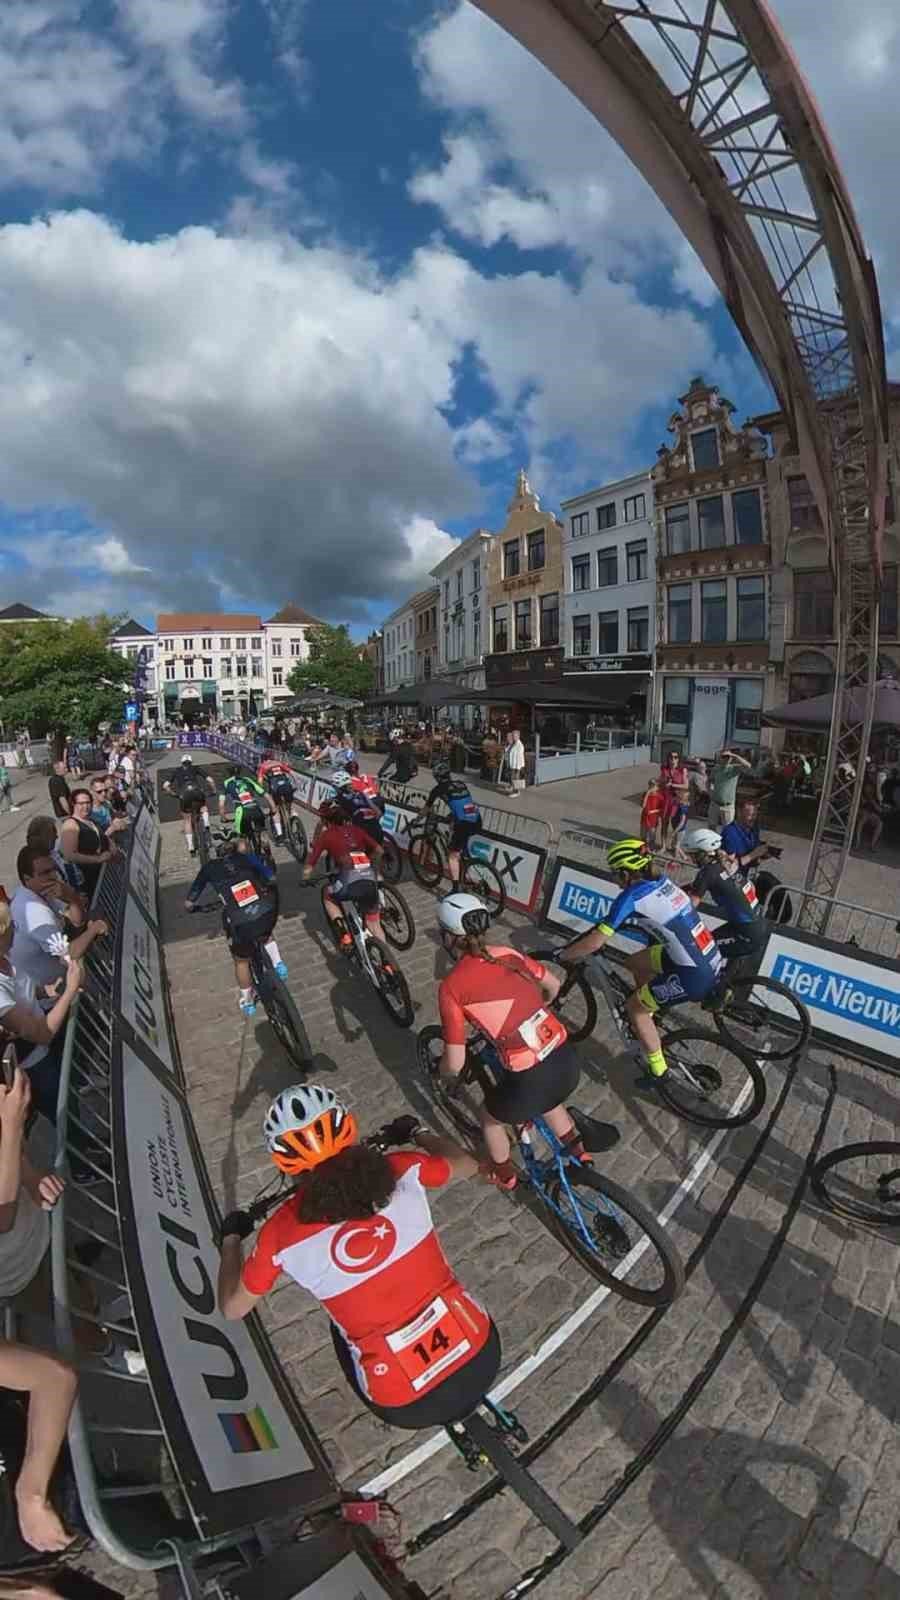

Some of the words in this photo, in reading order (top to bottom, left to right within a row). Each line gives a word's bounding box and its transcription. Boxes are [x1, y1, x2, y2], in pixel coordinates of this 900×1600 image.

[564, 884, 596, 915] Het
[779, 959, 824, 1001] Het
[821, 974, 900, 1030] Nieuw
[147, 1139, 164, 1199] UNION
[157, 1135, 178, 1208] CYCLISTE
[158, 1211, 249, 1401] UCI
[412, 1326, 450, 1365] 14
